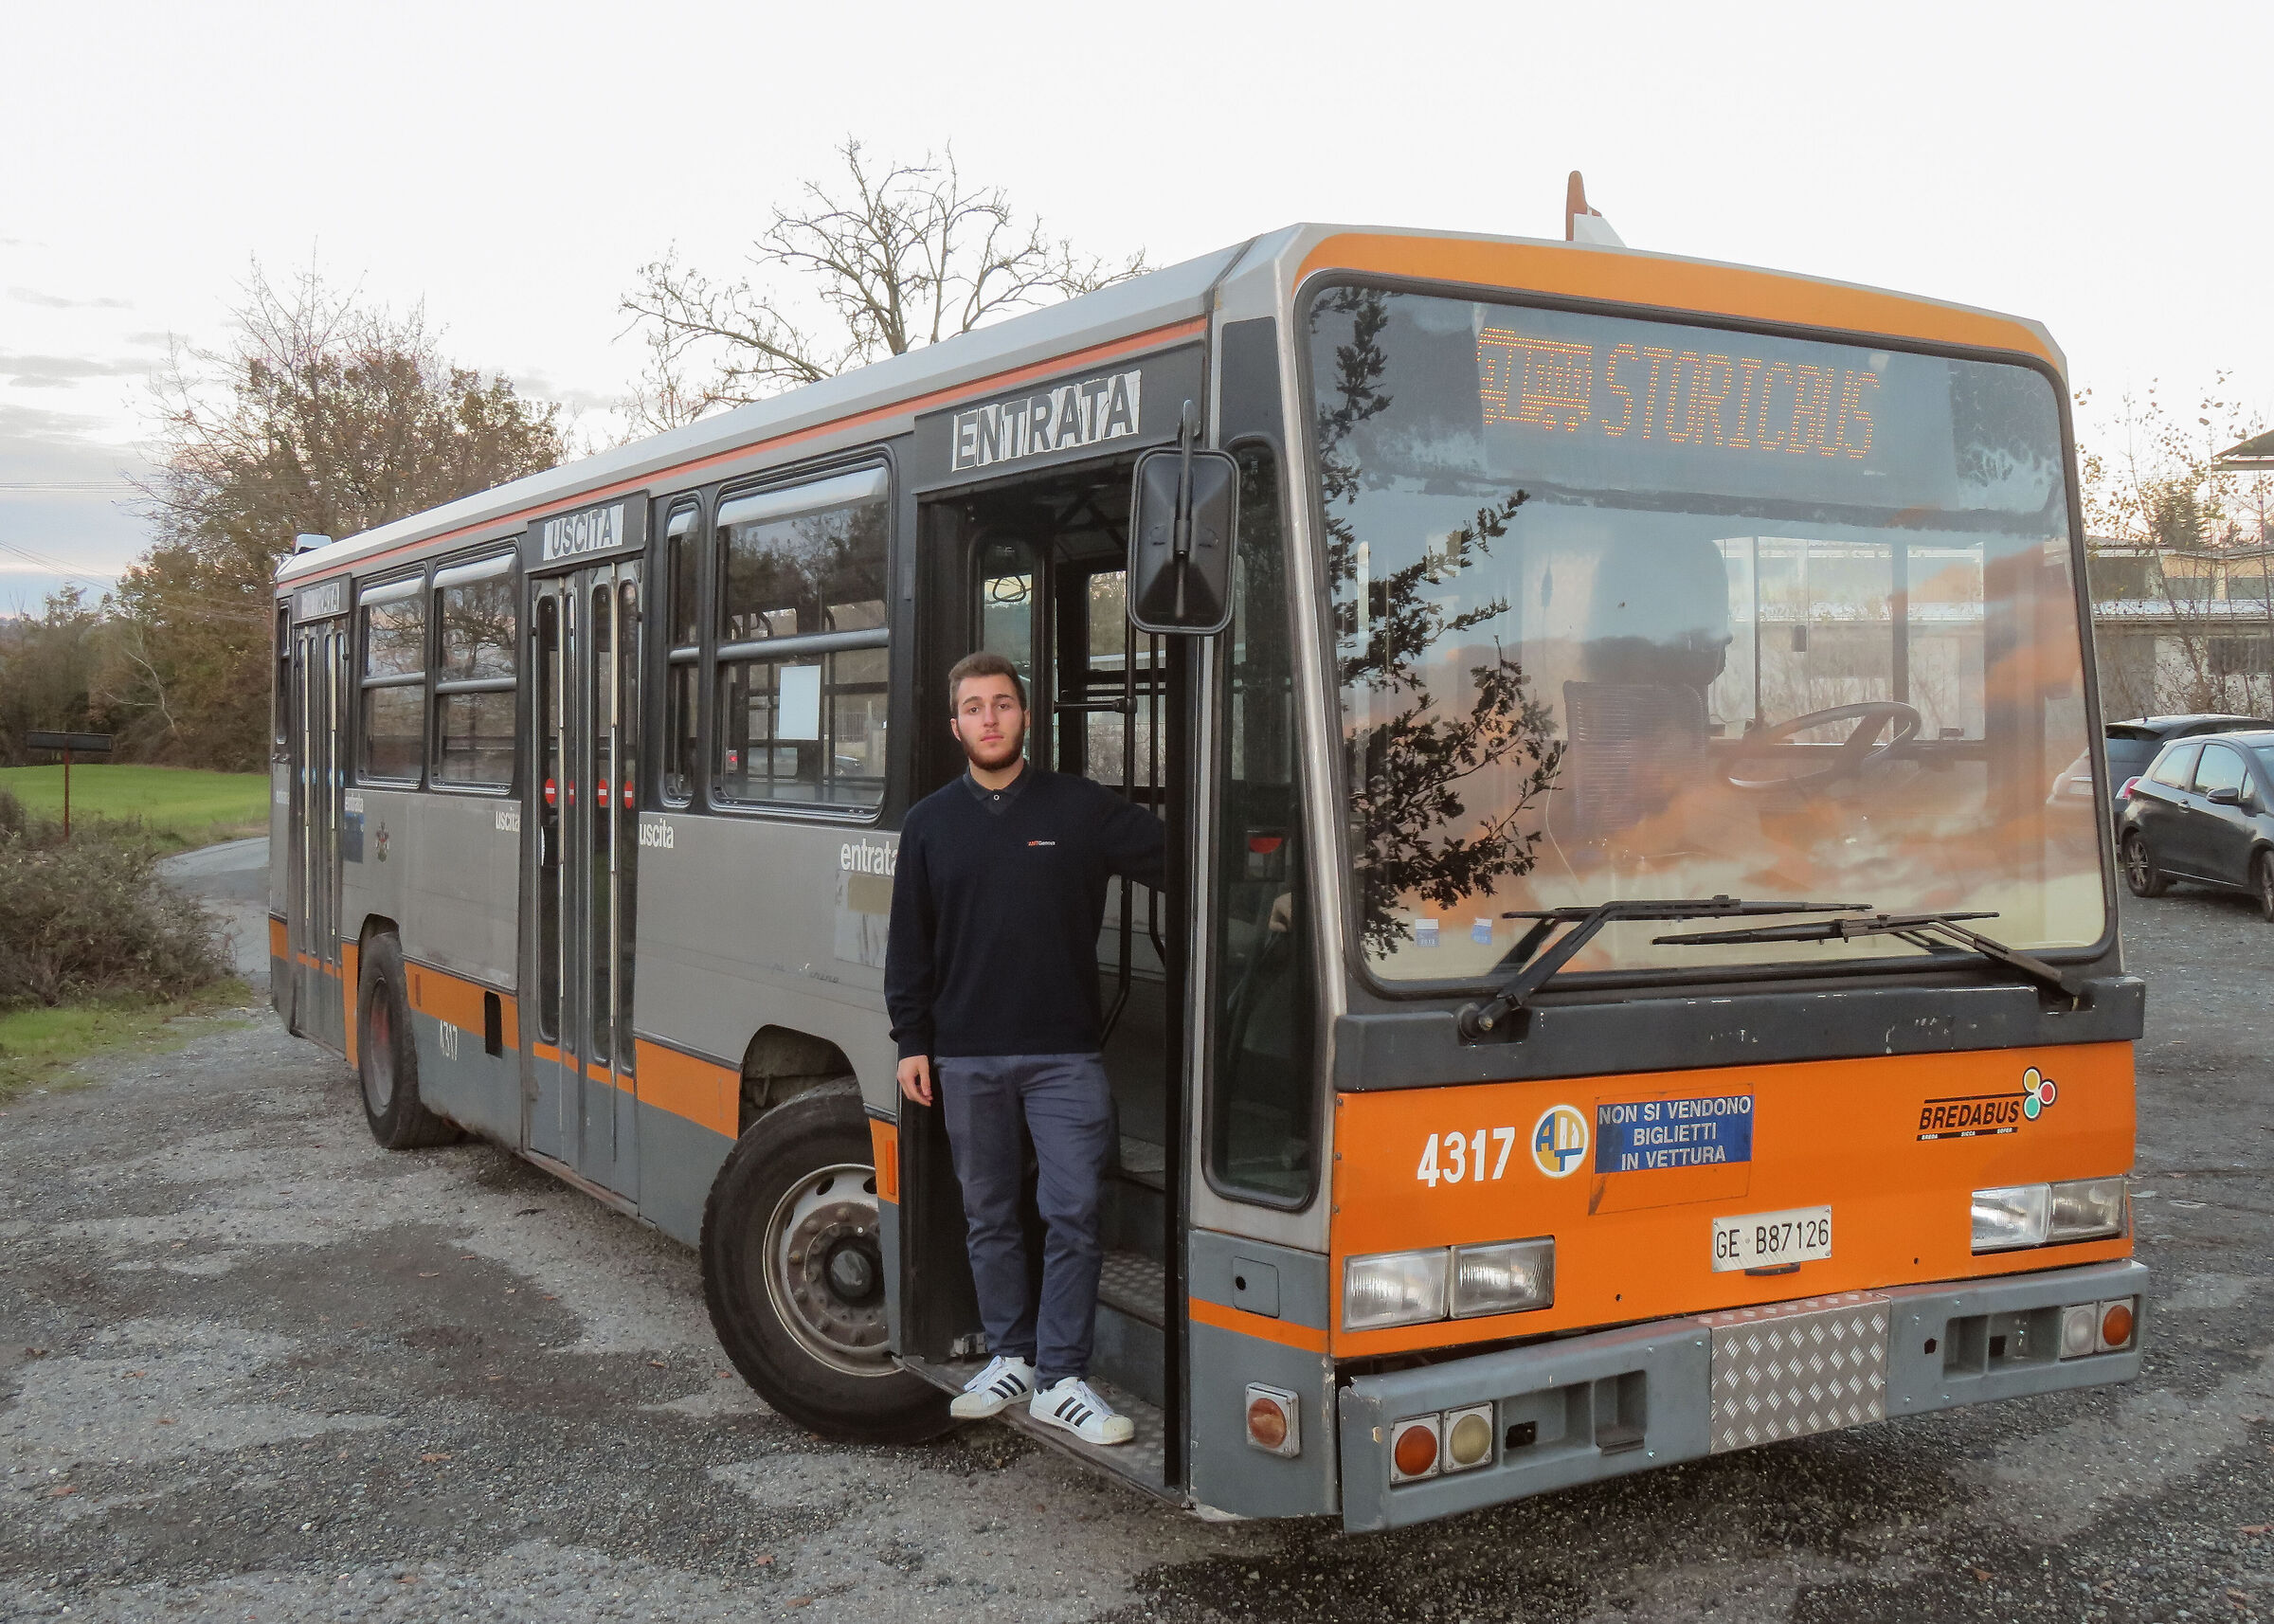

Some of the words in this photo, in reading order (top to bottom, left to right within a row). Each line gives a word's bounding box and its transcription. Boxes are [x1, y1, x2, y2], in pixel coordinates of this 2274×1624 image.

[1600, 342, 1881, 460] STORICBUS
[955, 374, 1135, 470] ENTRATA
[551, 507, 614, 558] USCITA
[495, 805, 520, 833] uscita
[640, 818, 675, 849] uscita
[1597, 1104, 1637, 1126] NON
[1643, 1101, 1660, 1122] SI
[1667, 1094, 1752, 1120] VENDONO
[1919, 1100, 2020, 1130] BREDABUS
[1633, 1121, 1718, 1147] BIGLIETTI
[1417, 1126, 1516, 1188] 4317
[1621, 1151, 1639, 1172] IN
[1644, 1145, 1727, 1169] VETTURA
[1716, 1229, 1741, 1259] GE
[1756, 1218, 1830, 1254] B87126
